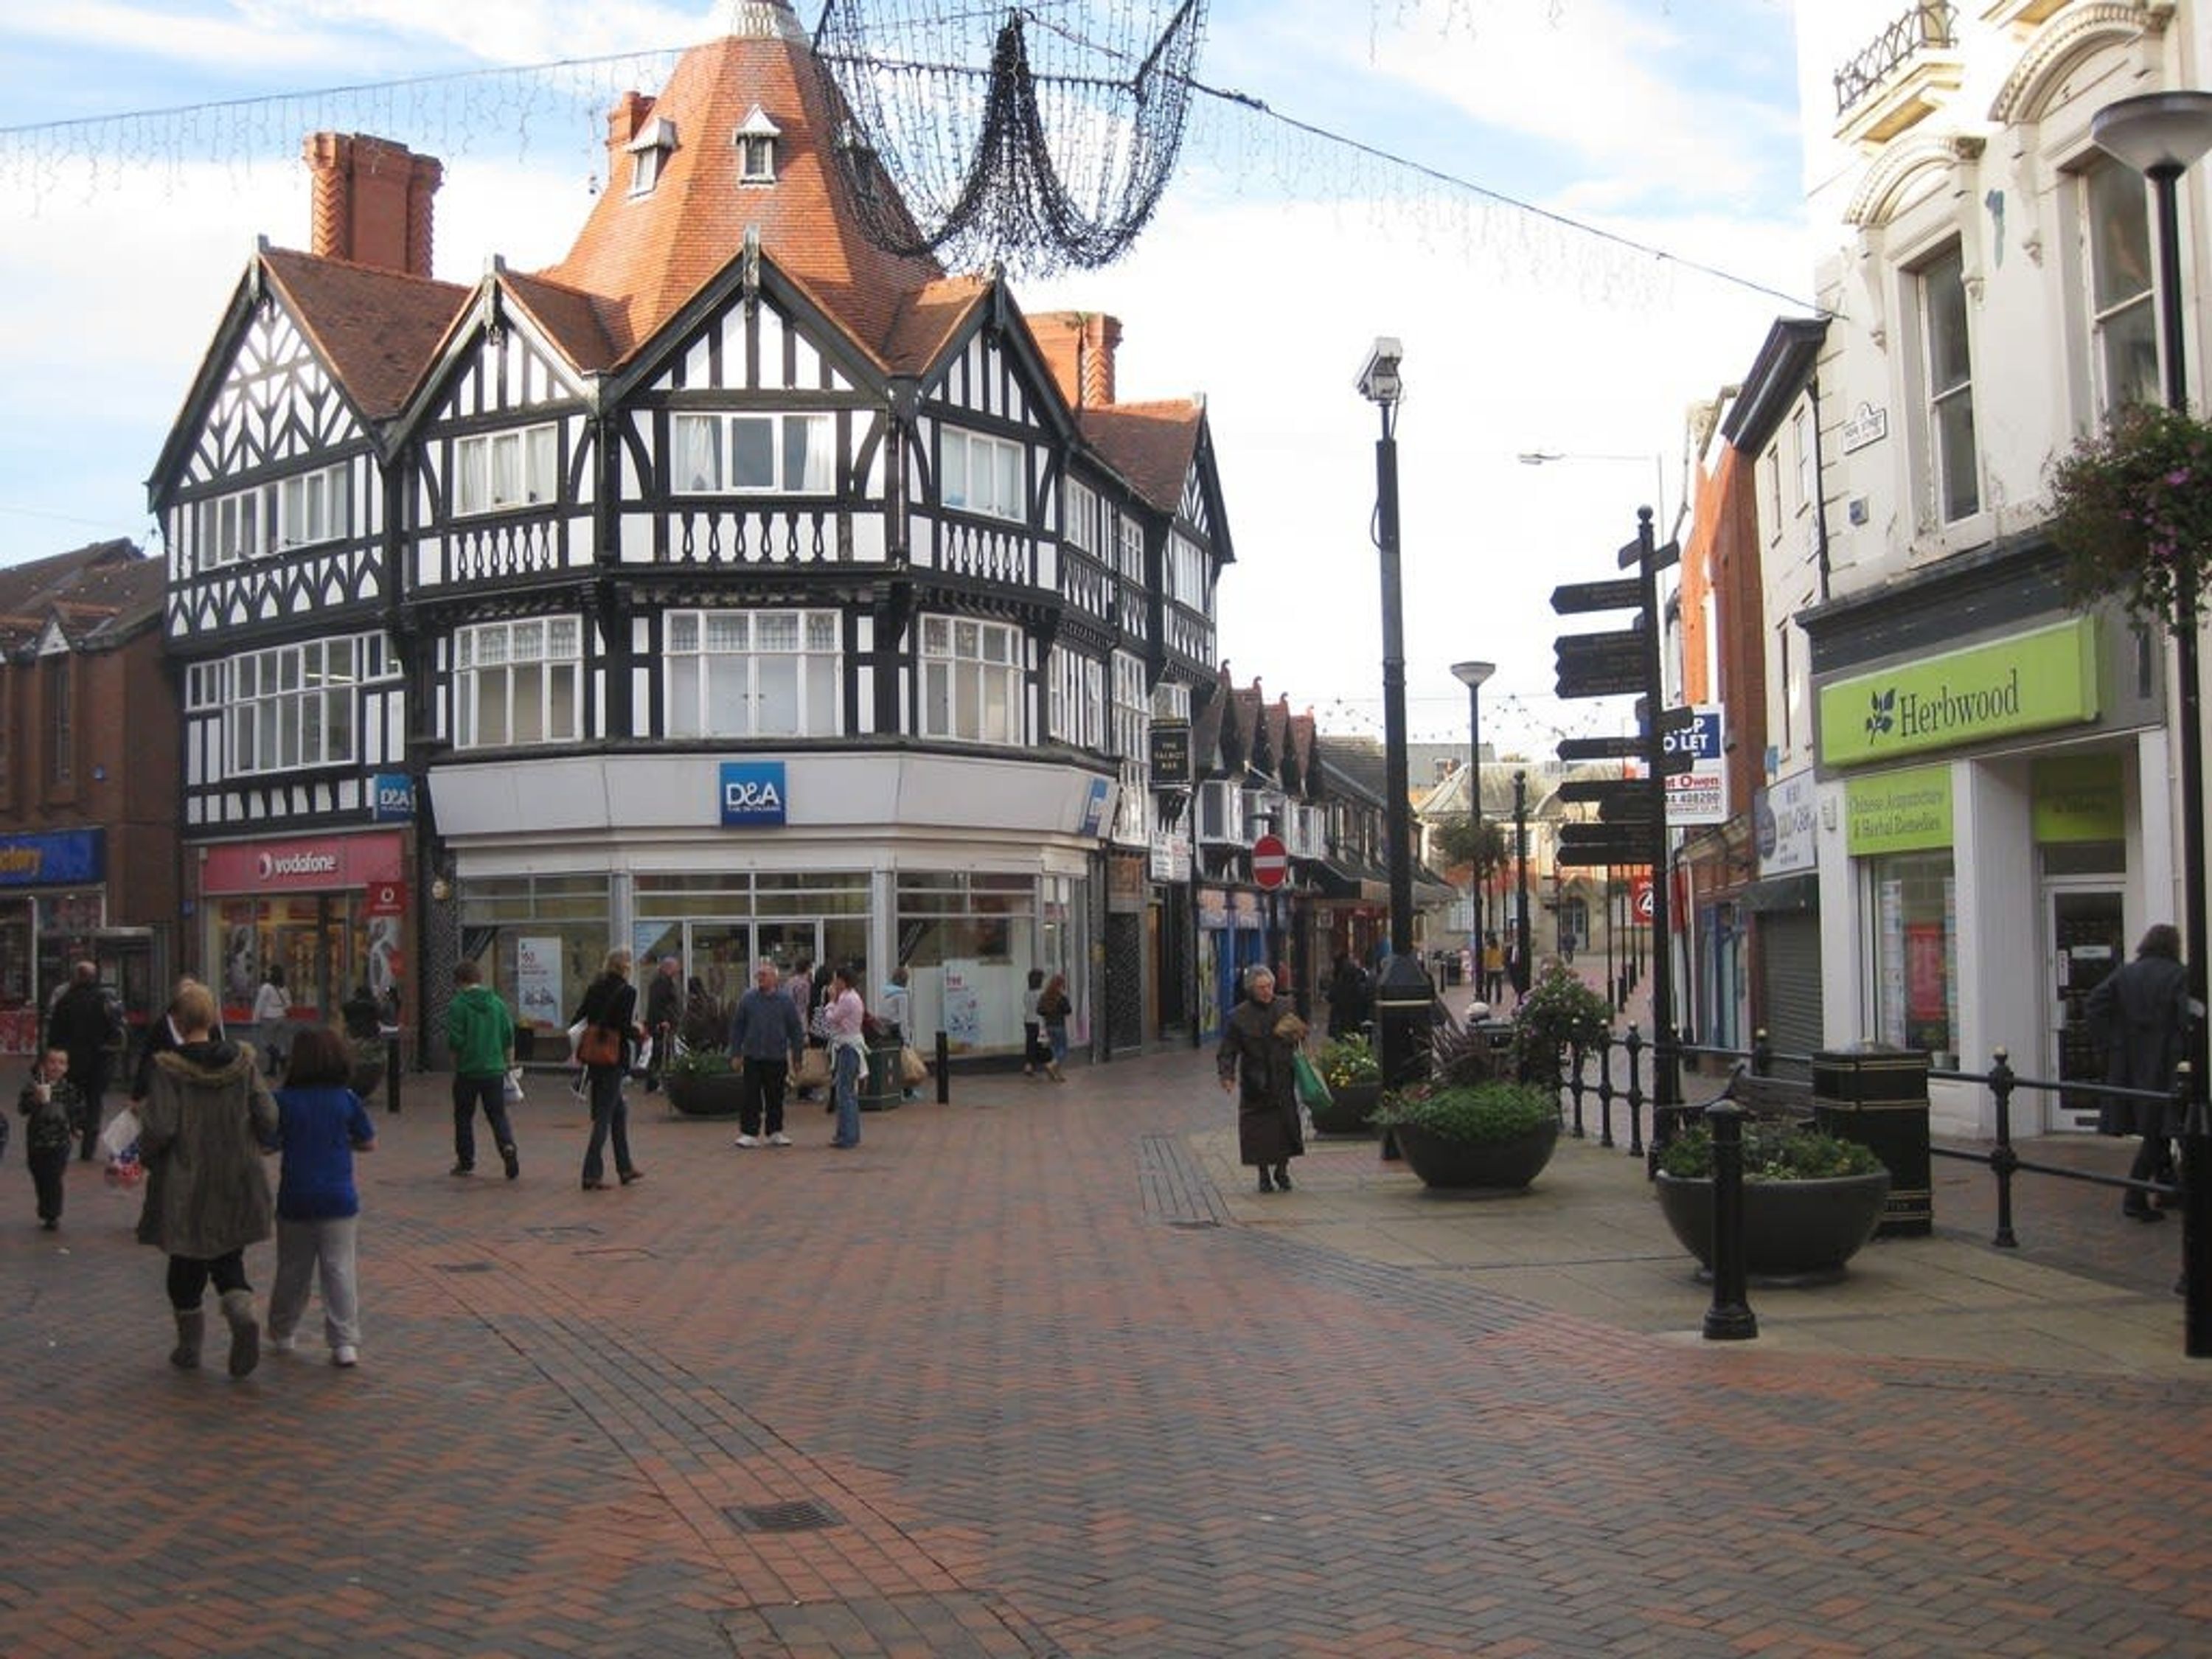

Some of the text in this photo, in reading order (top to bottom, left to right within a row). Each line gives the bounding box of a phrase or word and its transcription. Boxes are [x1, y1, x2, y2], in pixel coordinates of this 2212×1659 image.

[1900, 668, 2019, 737] Herbwood
[1663, 736, 1677, 751] O
[1680, 734, 1709, 751] LET
[726, 782, 780, 806] D&A
[1680, 775, 1719, 790] Owen
[274, 851, 336, 874] vodafone
